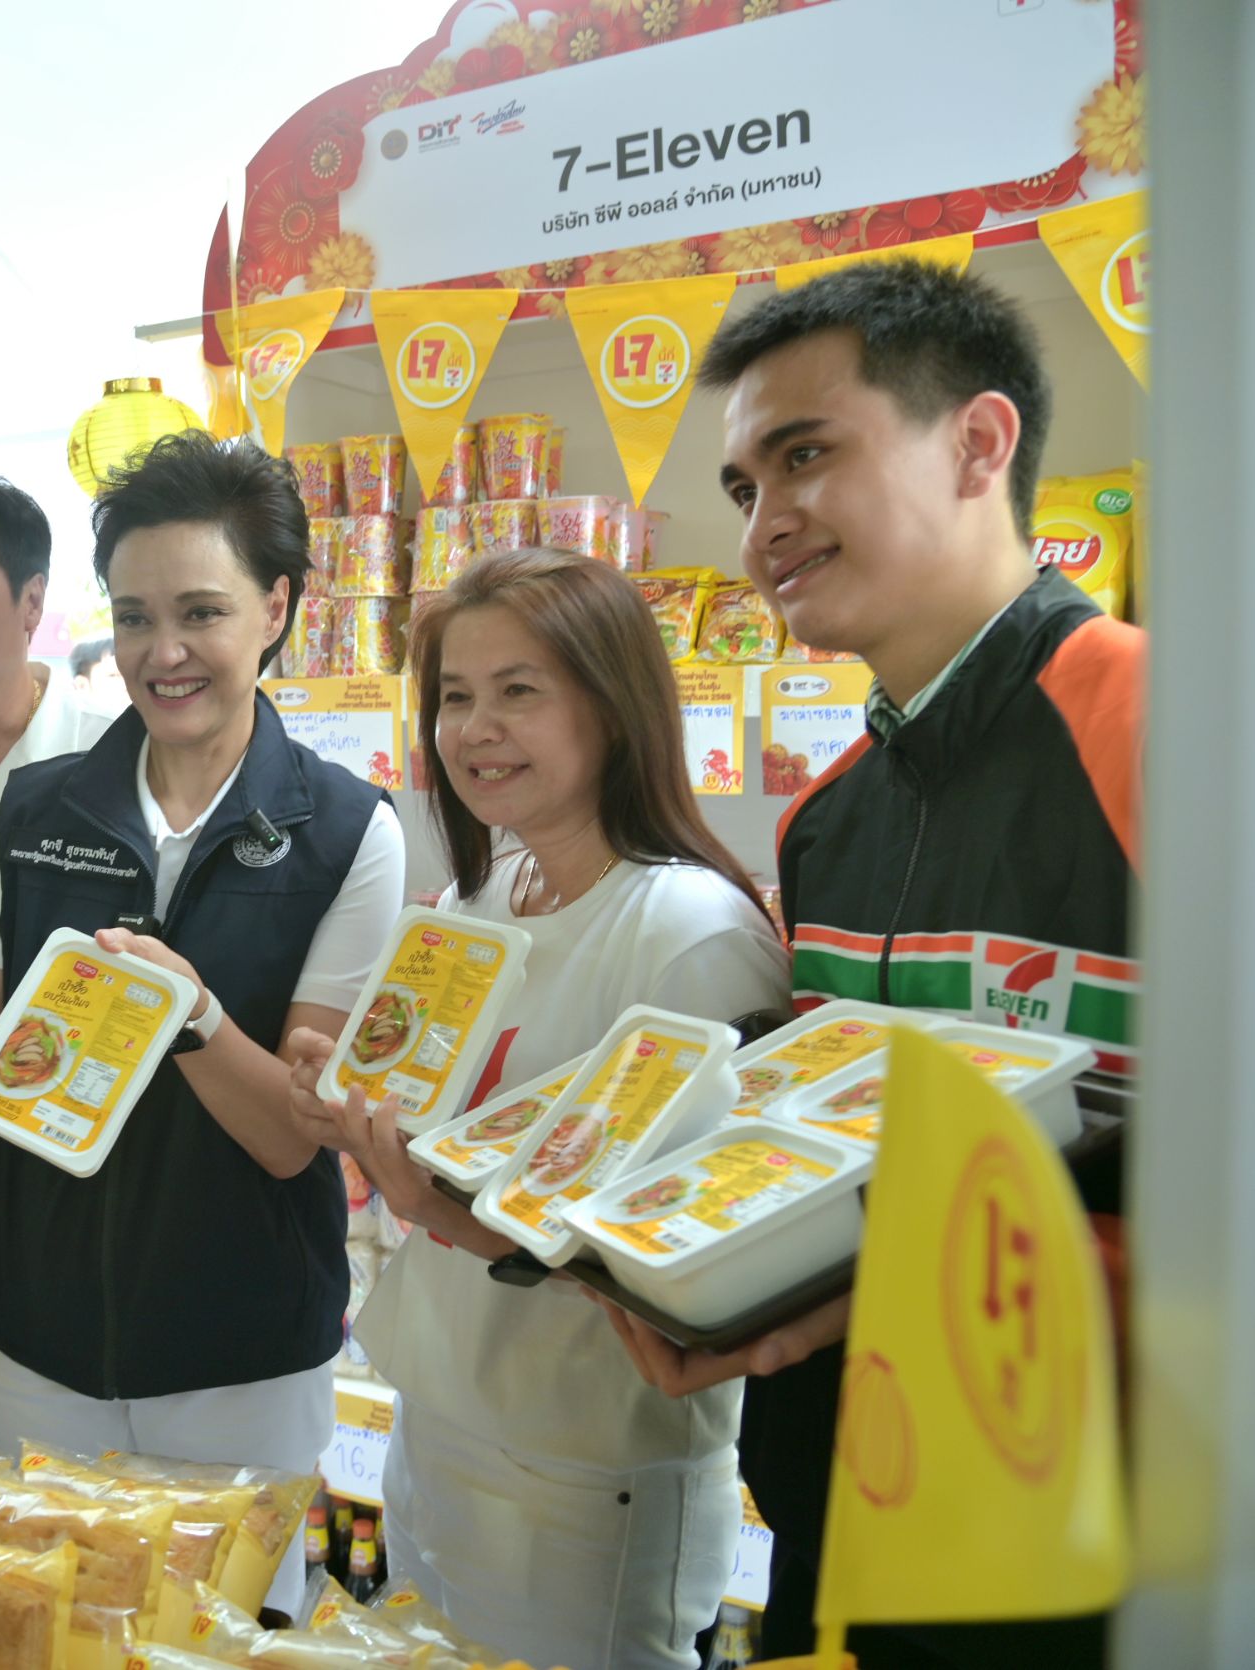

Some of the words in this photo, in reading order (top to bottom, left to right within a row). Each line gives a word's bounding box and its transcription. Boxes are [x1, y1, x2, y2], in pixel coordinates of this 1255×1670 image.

[552, 109, 812, 193] 7-Eleven
[542, 211, 590, 235] บริษัท
[594, 201, 623, 225] ซีพี
[627, 192, 678, 219] ออลล์
[683, 181, 735, 208] จำกัด
[740, 166, 822, 201] (มหาชน)
[1098, 492, 1129, 511] BIG
[65, 844, 119, 866] สุธรรมพันธุ์
